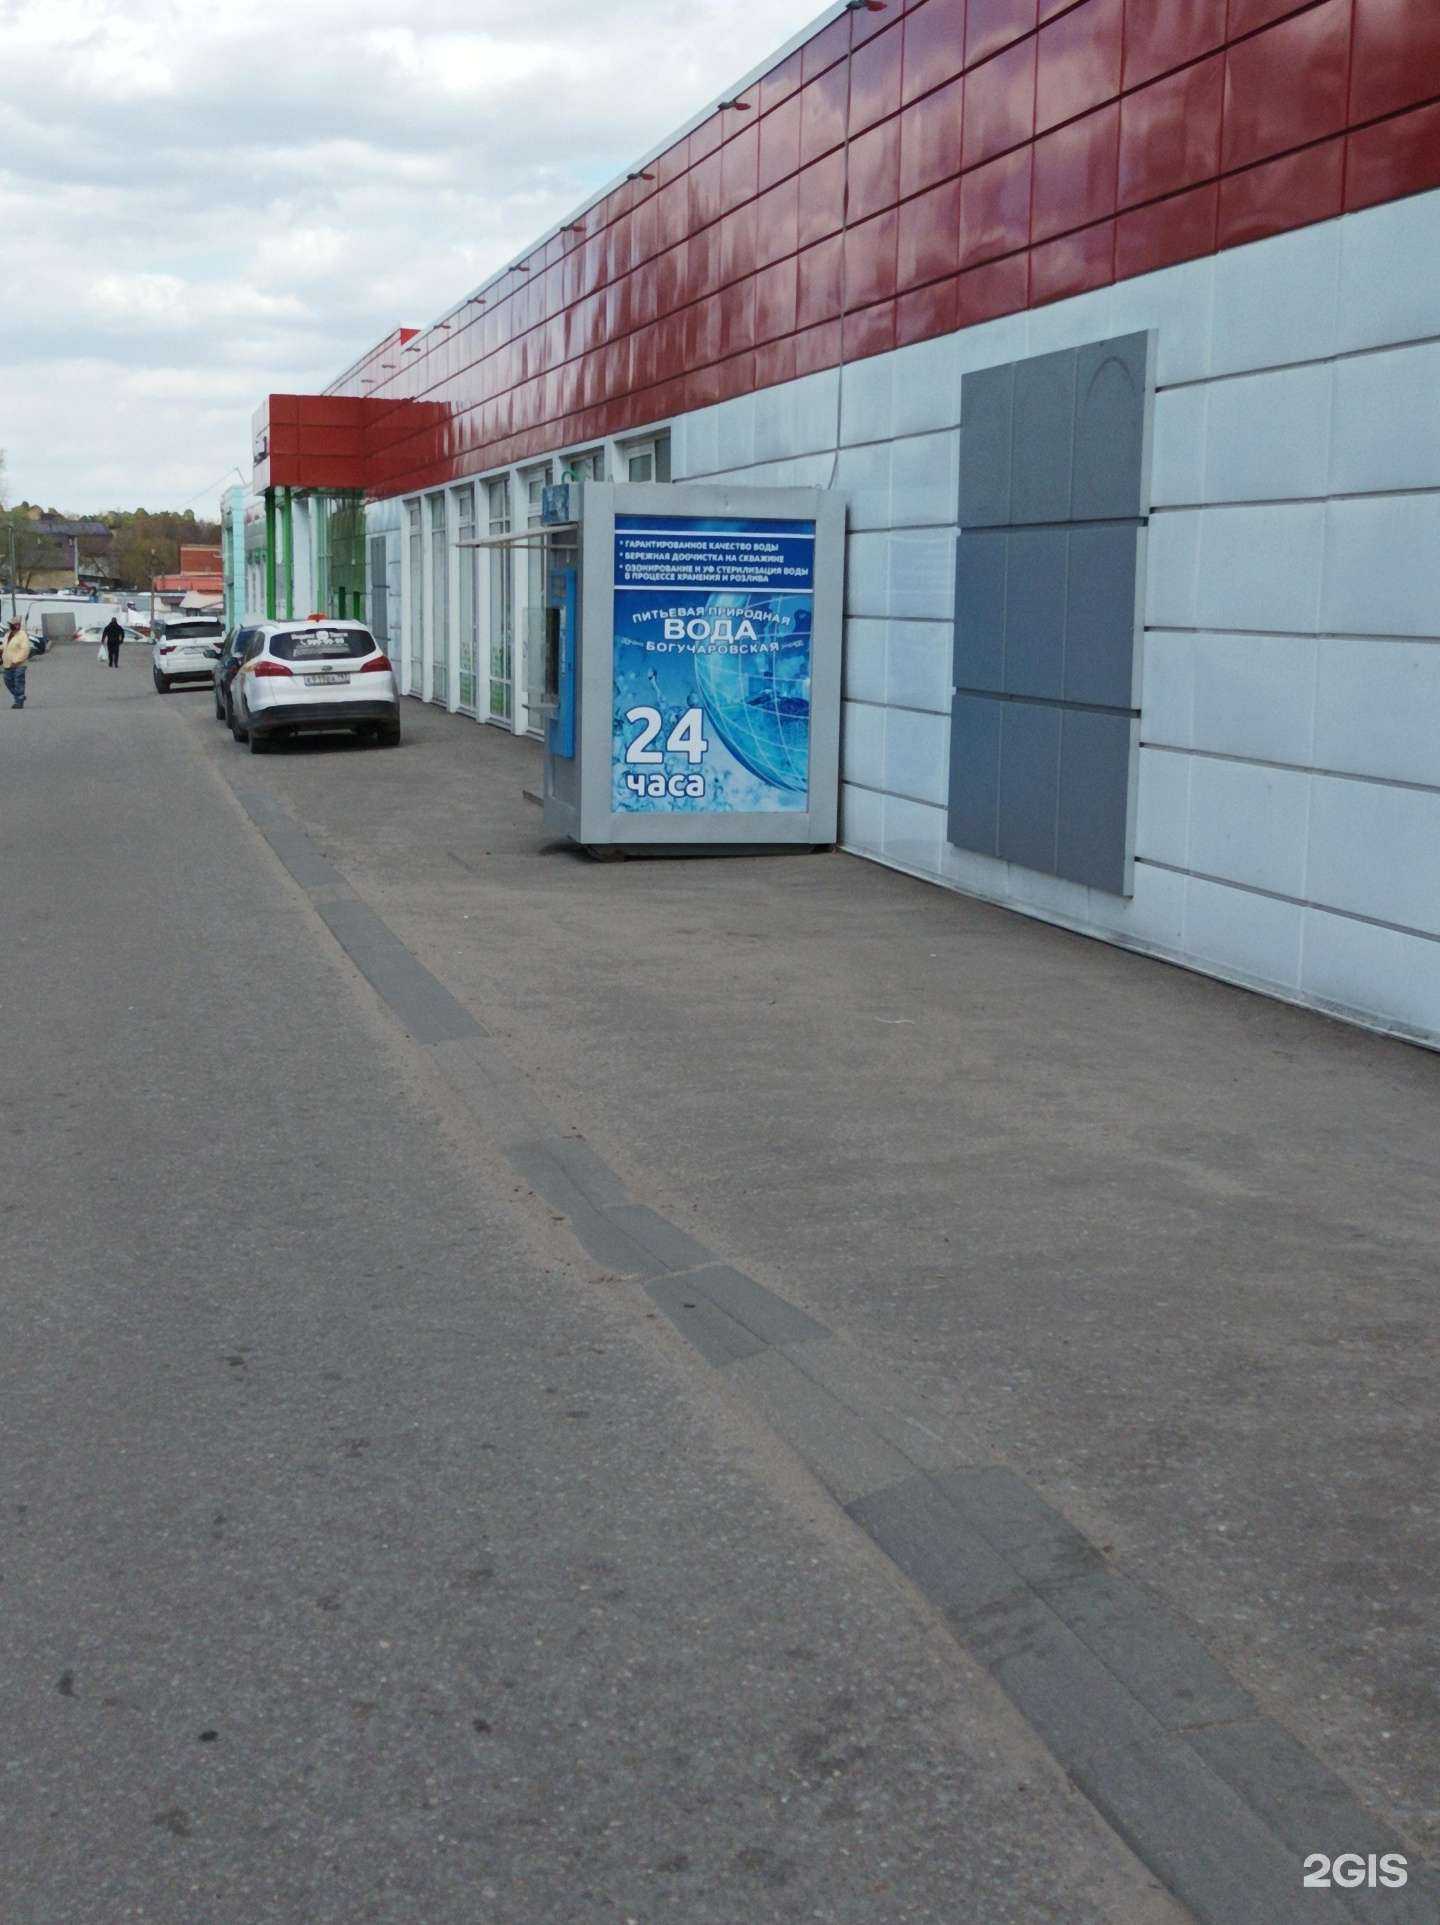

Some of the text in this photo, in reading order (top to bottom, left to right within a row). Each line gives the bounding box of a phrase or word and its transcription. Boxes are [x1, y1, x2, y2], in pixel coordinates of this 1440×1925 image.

[625, 540, 779, 553] ГАРАНТИРОВАННОЕ КАЧЕСТВО ВОДЫ
[625, 551, 785, 563] БЕРЕЖНАЯ ДООЧИСТКА НА СКВАЖИНЕ
[625, 563, 809, 577] ОЗОНИРОВАНИЕ И УФ СТЕРИЛИЗАЦИЯ ВОДЫ
[624, 573, 769, 584] В ПРОЦЕССЕ ХРАНЕНИЯ И РОЗЛИВА
[632, 606, 791, 626] ПИТЬЕВАЯ ПРИРОДНАЯ
[663, 618, 757, 644] ВОДА
[646, 640, 780, 655] БОГУЧАРОВСКАЯ
[625, 705, 709, 765] 24
[626, 773, 705, 798] часа
